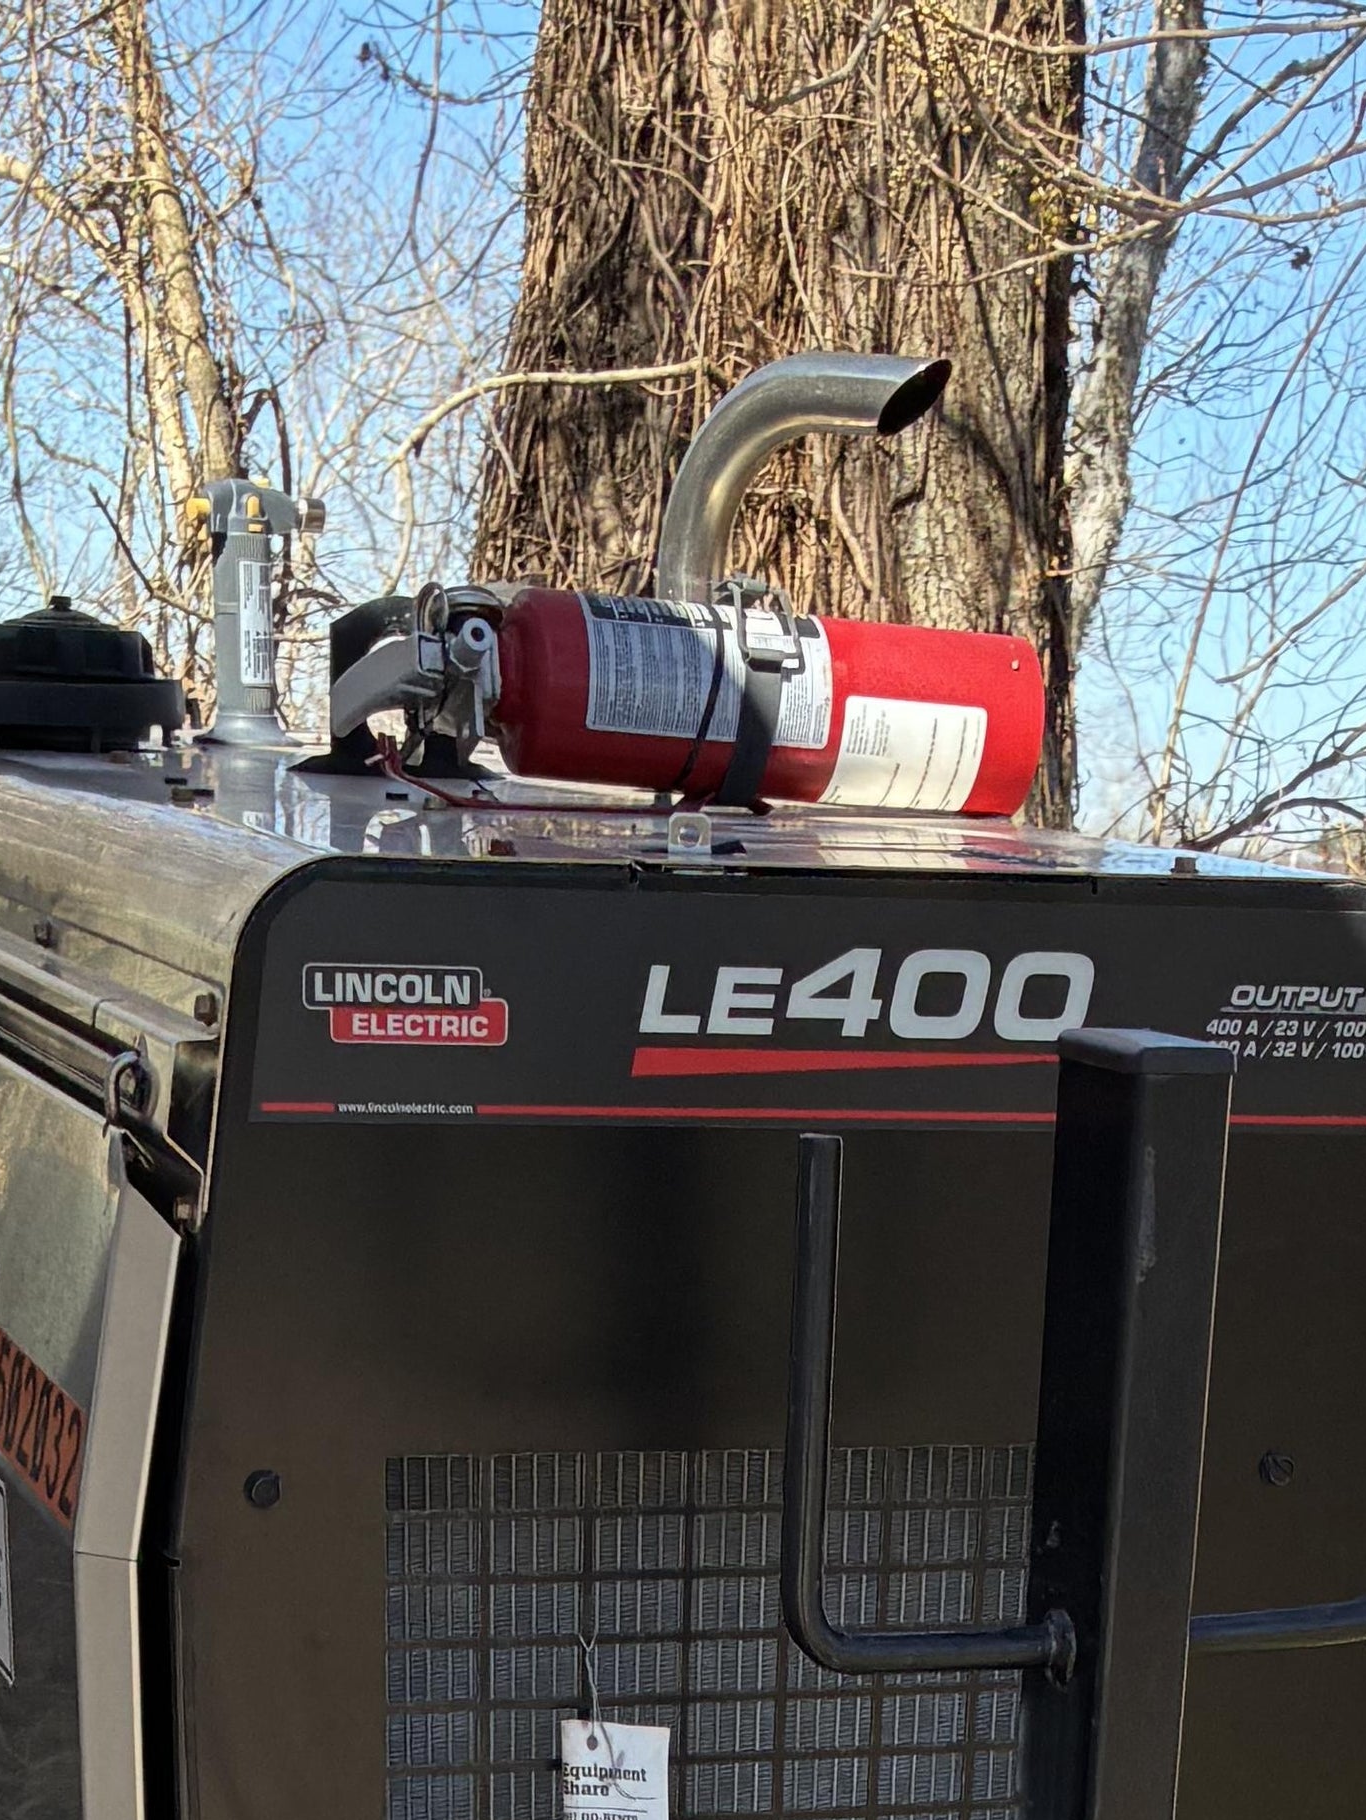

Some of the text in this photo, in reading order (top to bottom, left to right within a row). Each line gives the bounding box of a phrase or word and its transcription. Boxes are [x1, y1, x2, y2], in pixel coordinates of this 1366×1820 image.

[314, 972, 470, 1005] LINCOLN
[639, 949, 1094, 1041] LE400
[1230, 985, 1364, 1008] OUTPUT
[351, 1013, 489, 1038] ELECTRIC
[1206, 1019, 1242, 1035] 400
[1245, 1020, 1258, 1035] A
[1274, 1020, 1298, 1036] 23
[1303, 1021, 1317, 1037] V
[1243, 1041, 1257, 1057] A
[1272, 1041, 1296, 1057] 32
[1301, 1042, 1315, 1058] V
[563, 1762, 647, 1783] Equipment
